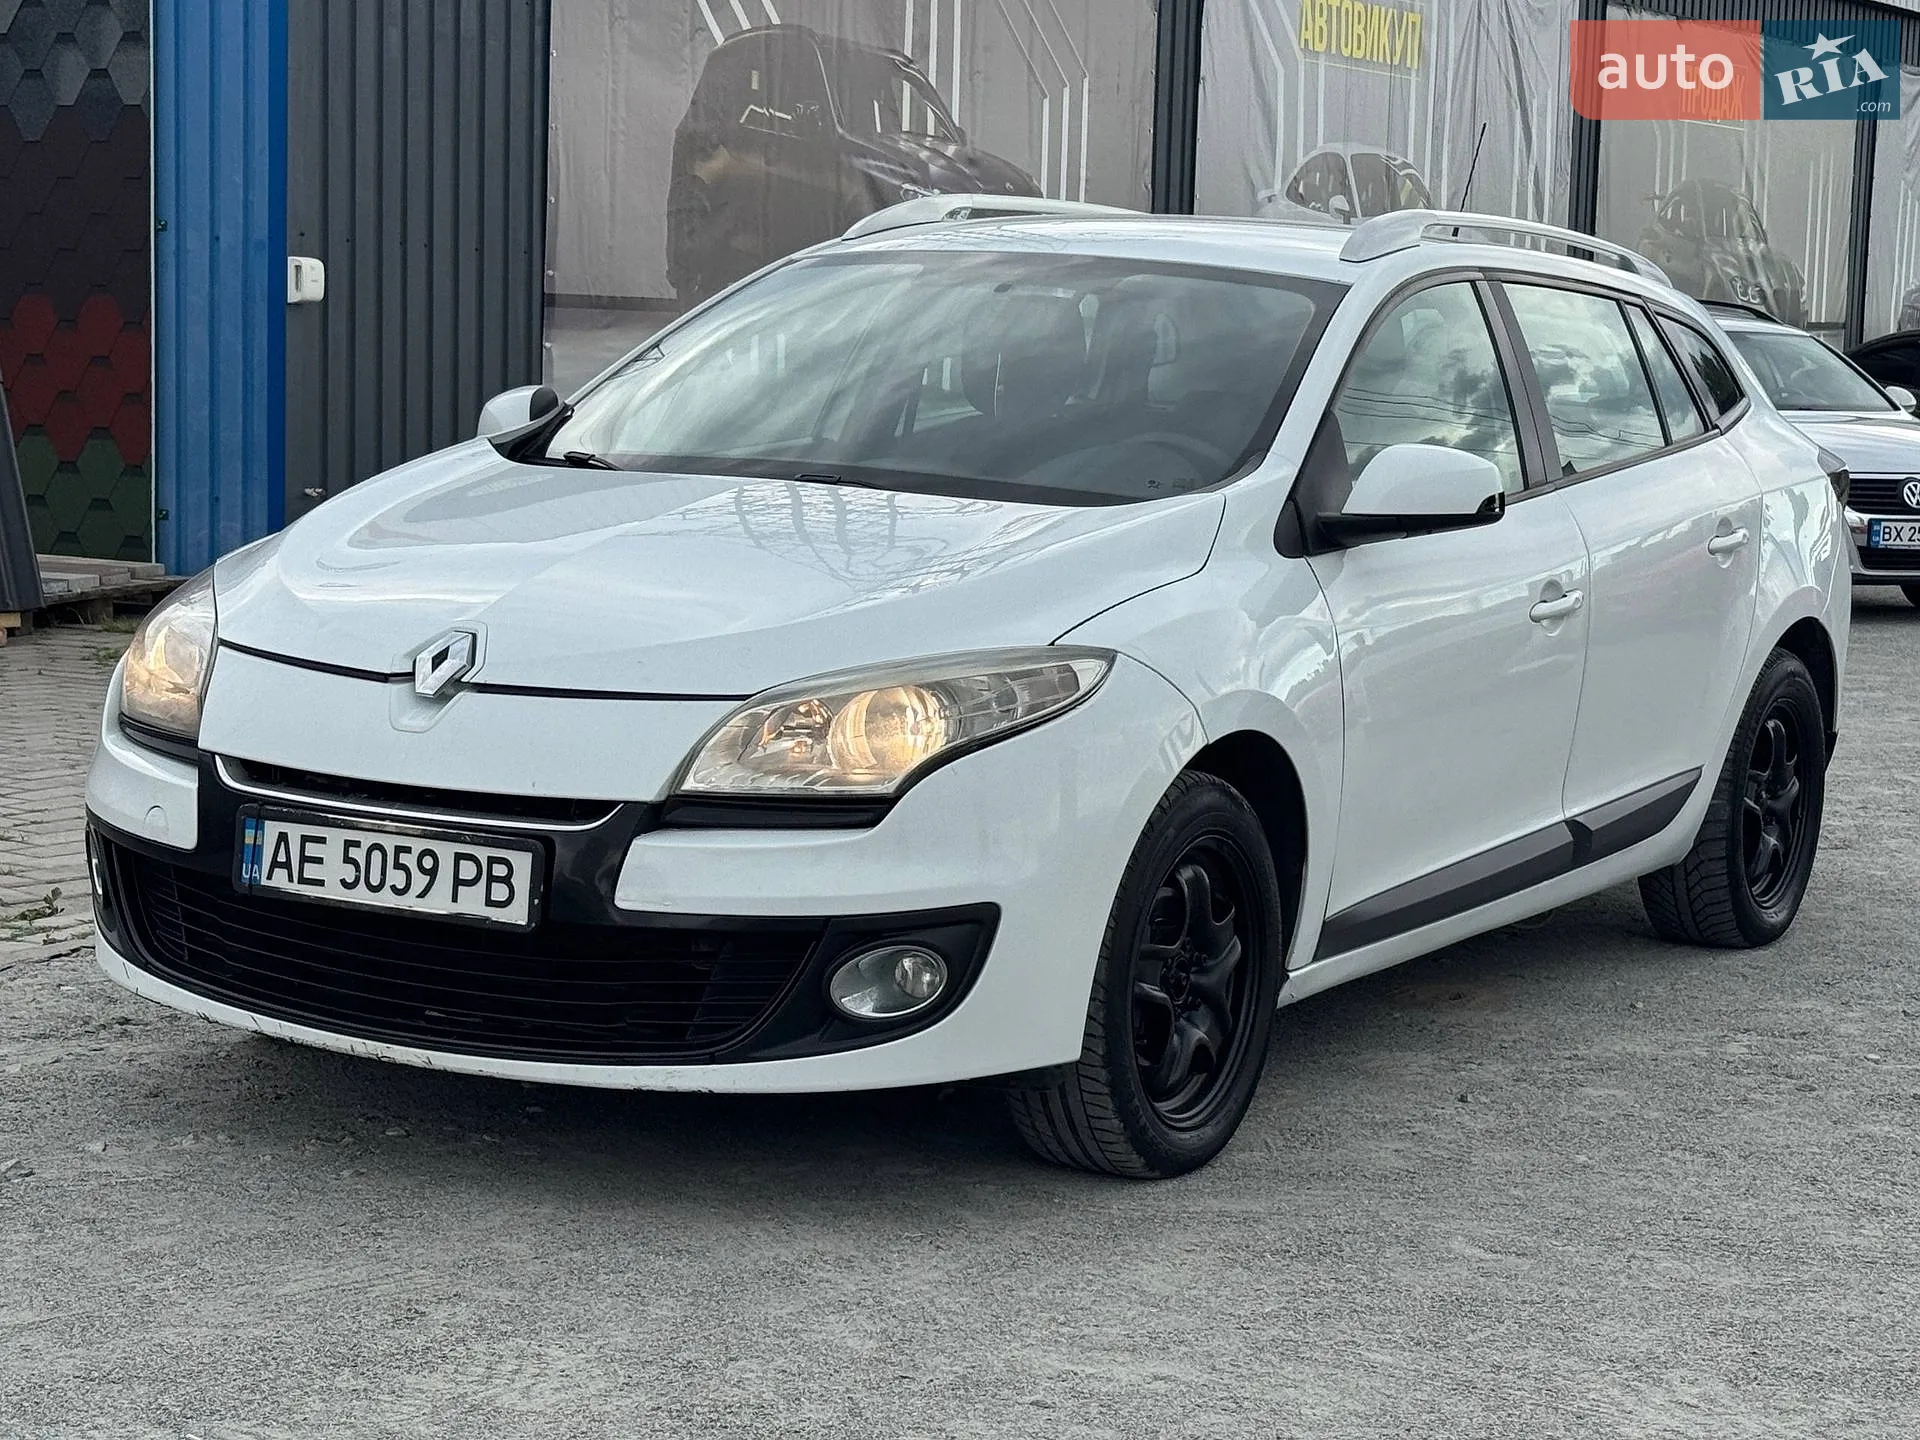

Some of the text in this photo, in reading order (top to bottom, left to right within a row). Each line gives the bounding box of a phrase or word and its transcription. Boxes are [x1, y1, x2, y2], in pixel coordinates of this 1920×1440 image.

[1300, 0, 1421, 69] АВТОВИКУП
[1882, 526, 1904, 542] BX
[242, 862, 260, 880] UA
[266, 831, 515, 907] AE 5059 PB
